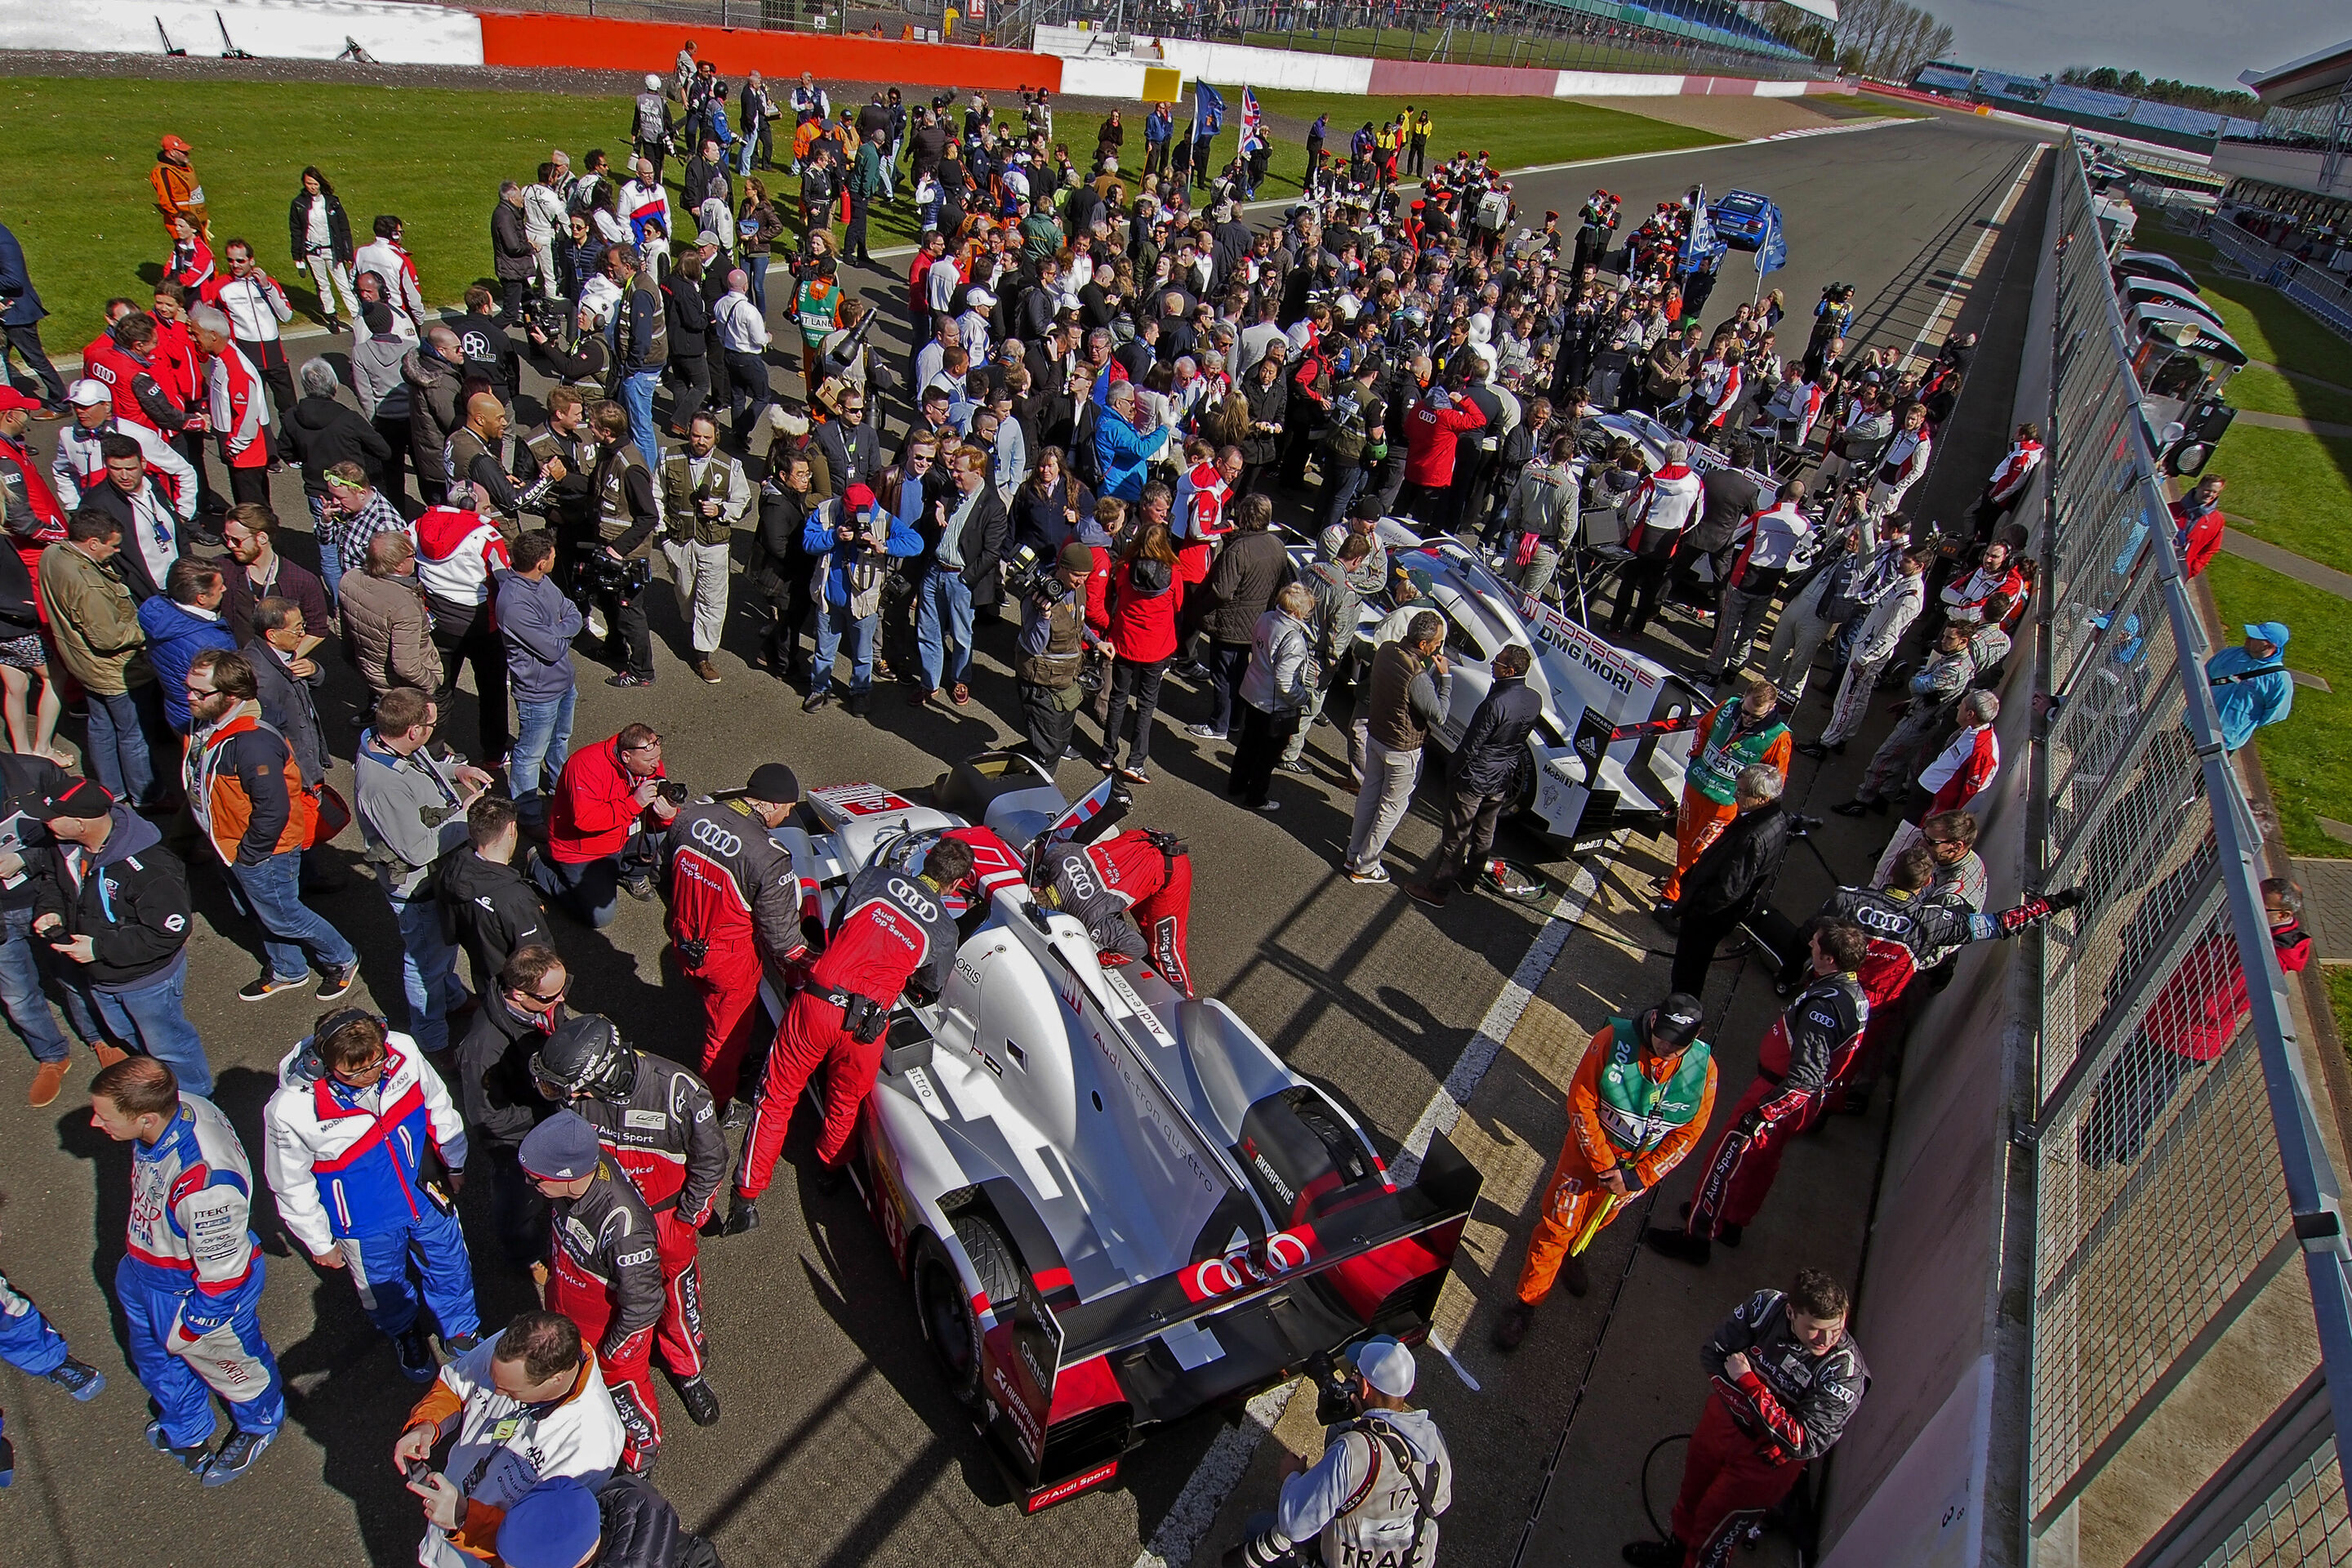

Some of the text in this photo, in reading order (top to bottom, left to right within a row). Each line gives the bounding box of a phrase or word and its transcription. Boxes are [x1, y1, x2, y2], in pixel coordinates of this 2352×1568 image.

[1348, 389, 1357, 400] 5
[583, 445, 596, 461] 28
[524, 477, 548, 501] crew
[605, 473, 621, 492] 24
[714, 473, 723, 488] 9
[1537, 624, 1633, 695] DMG MORI
[1545, 611, 1656, 690] PORSCHE
[1776, 688, 1797, 703] OPARD
[1584, 709, 1613, 731] CHOPARD
[1576, 741, 1597, 759] adidas
[1542, 764, 1566, 785] Mobil
[1573, 842, 1593, 853] Mobil
[680, 856, 699, 872] Audi
[679, 862, 723, 893] Top Srvice
[873, 907, 898, 924] Audi
[870, 912, 917, 952] Top Service
[956, 956, 982, 985] ORIS
[1160, 949, 1177, 973] Audi
[1113, 974, 1165, 1036] Audi e-tron
[571, 1051, 617, 1092] uvex
[1607, 1039, 1631, 1085] 2015
[385, 1071, 410, 1094] DENSO
[908, 1067, 932, 1098] attro
[1092, 1031, 1214, 1193] Audi e-tron quattro
[622, 1132, 654, 1143] Sport
[625, 1164, 655, 1175] rvice
[1707, 1140, 1740, 1201] Audi Sport
[194, 1204, 230, 1221] JTEKT
[884, 1197, 897, 1249] 8
[564, 1236, 586, 1264] Sport
[555, 1266, 587, 1289] ervice
[685, 1274, 696, 1308] Sport
[1031, 1301, 1058, 1348] BOSCH
[216, 1359, 250, 1385] DENSO
[1021, 1340, 1047, 1389] ORIS
[1757, 1353, 1778, 1376] Audi
[628, 1417, 652, 1447] Audi
[1008, 1405, 1038, 1454] MAHLE
[1050, 1467, 1111, 1499] Audi Sport
